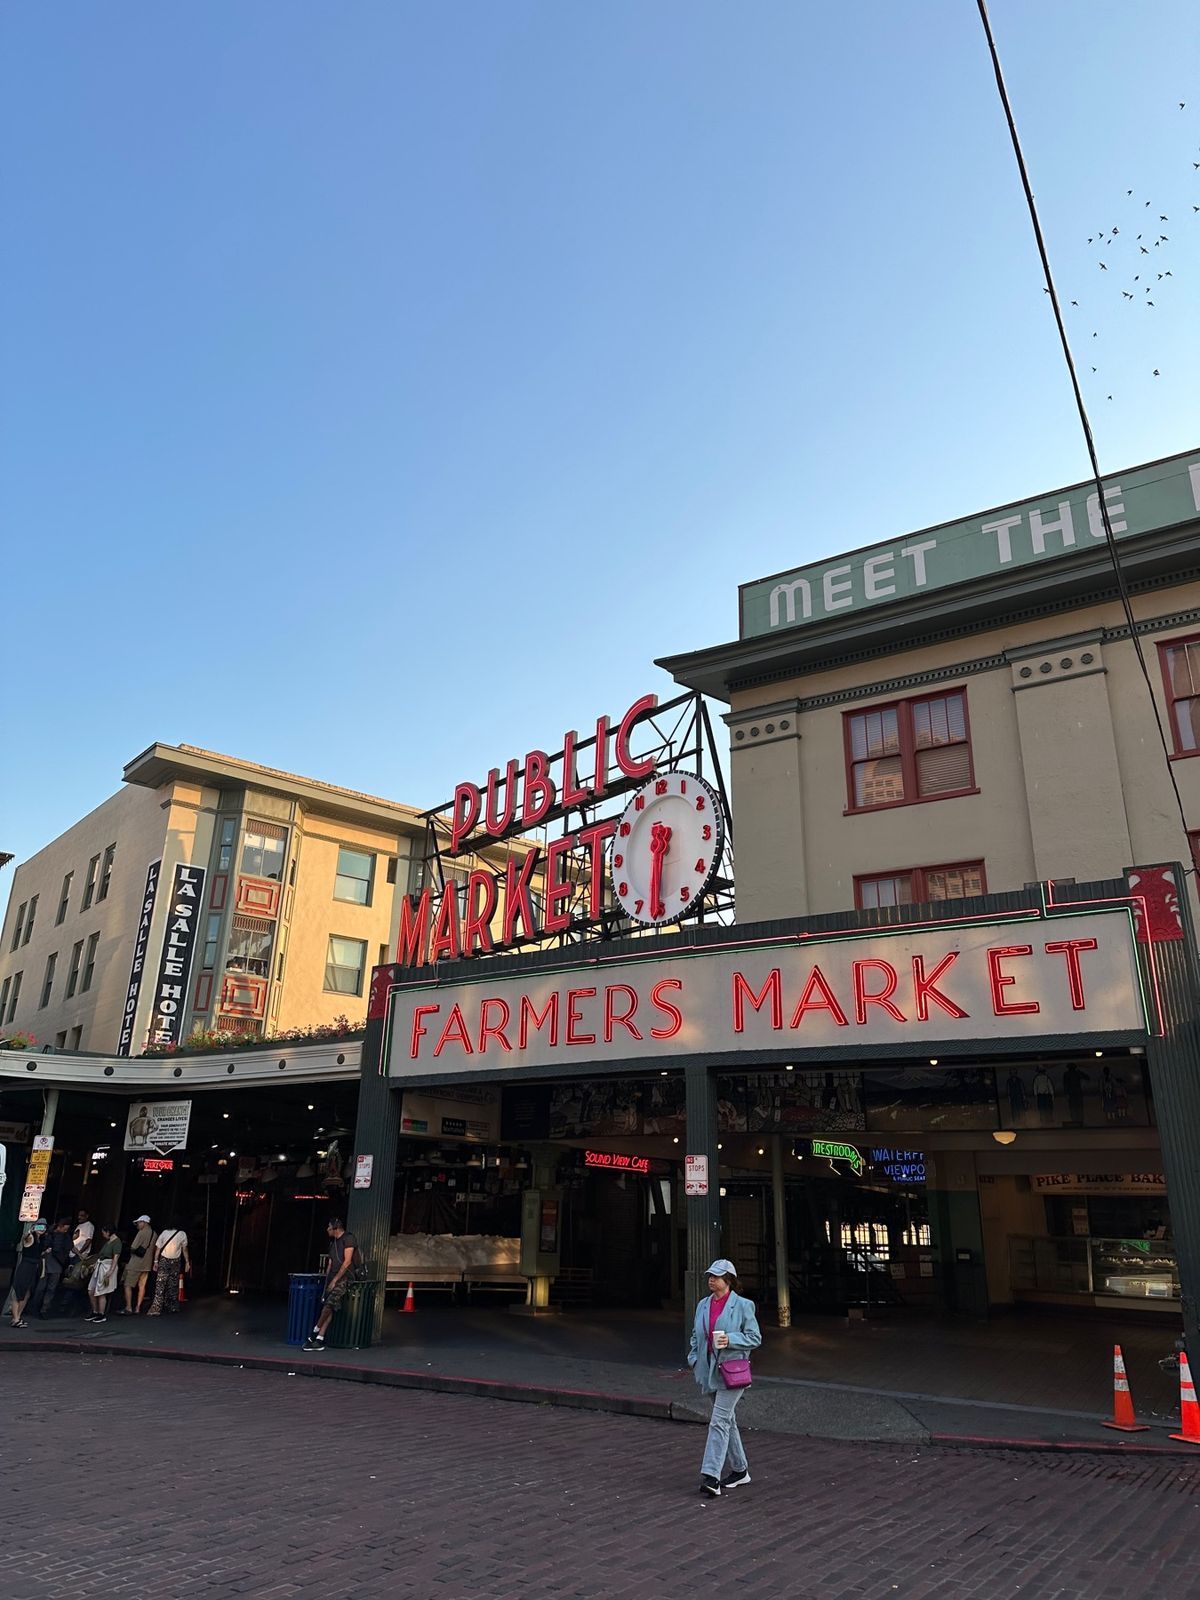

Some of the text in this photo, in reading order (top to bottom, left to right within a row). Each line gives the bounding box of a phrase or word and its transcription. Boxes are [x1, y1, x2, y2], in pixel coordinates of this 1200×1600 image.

[769, 540, 937, 627] MEET
[981, 485, 1128, 564] THE
[451, 694, 658, 854] PUBLIC
[655, 780, 668, 795] 12
[680, 781, 686, 794] 1
[635, 796, 645, 811] 11
[696, 796, 705, 811] 2
[619, 823, 631, 837] 10
[702, 825, 711, 841] 3
[614, 855, 623, 868] 9
[695, 859, 706, 874] 4
[146, 867, 157, 896] LA
[397, 819, 617, 968] MARKET
[618, 883, 629, 897] 8
[680, 887, 690, 902] 5
[634, 900, 644, 915] 7
[133, 899, 152, 974] SALLE
[154, 867, 198, 1045] LA SALLE HOTE
[410, 938, 1098, 1059] FARMERS MARKET
[585, 1150, 649, 1169] SOUND VIEW CAFE
[815, 1142, 861, 1169] RESTROOMS
[883, 1164, 926, 1175] VIEWPO
[1036, 1174, 1166, 1187] PIKE PLACE BAK
